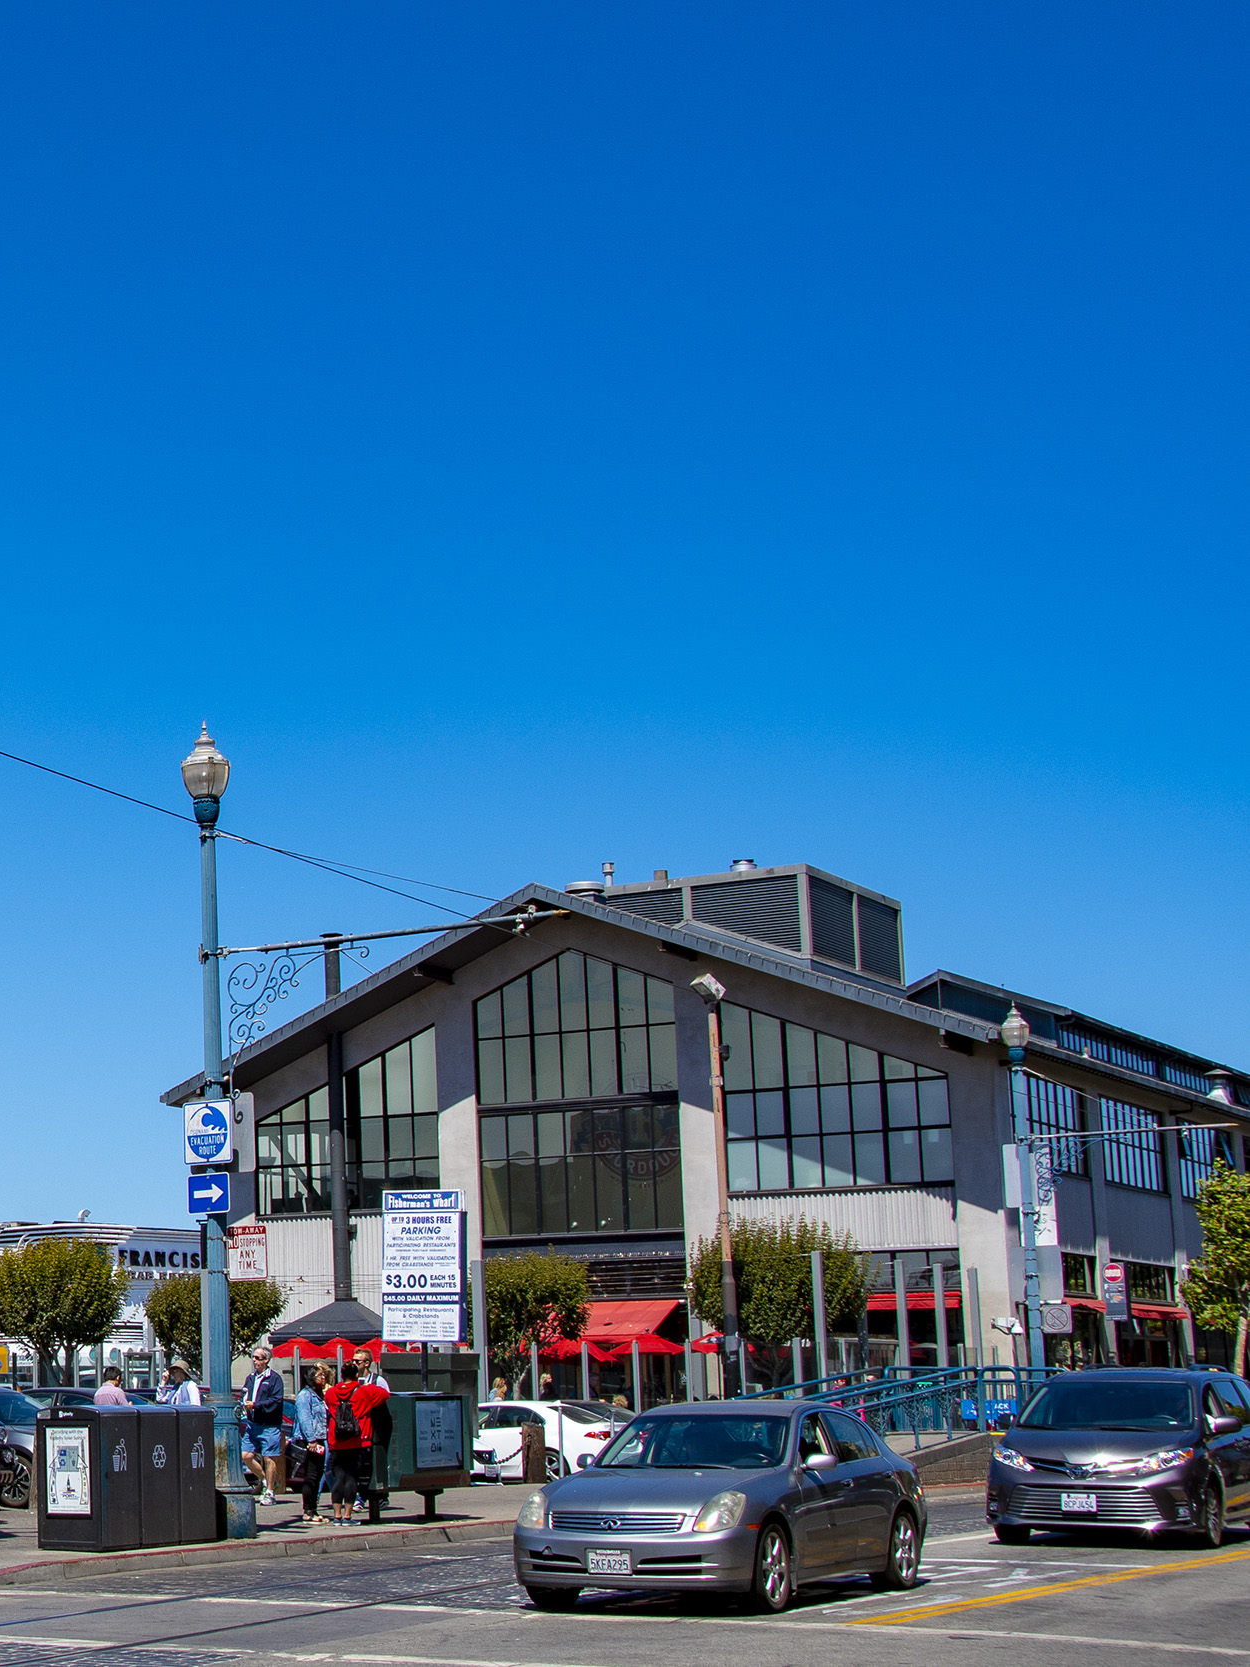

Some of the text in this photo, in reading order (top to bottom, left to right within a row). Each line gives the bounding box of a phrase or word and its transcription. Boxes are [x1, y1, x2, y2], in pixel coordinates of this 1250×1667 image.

[190, 1135, 225, 1147] EVACUATION
[198, 1145, 217, 1155] ROUTE
[388, 1193, 455, 1208] Fisherman's Wharf
[405, 1216, 410, 1224] 3
[411, 1216, 435, 1224] HOURS
[436, 1215, 452, 1224] FREE
[229, 1227, 264, 1235] TOW-AWAY
[400, 1226, 441, 1234] PARKING
[229, 1236, 265, 1248] NO STOPPING
[118, 1249, 200, 1269] FRANCIS
[239, 1250, 255, 1259] ANY
[238, 1260, 257, 1270] TIME
[385, 1274, 428, 1288] $3.00
[590, 1558, 629, 1571] 5KFA295
